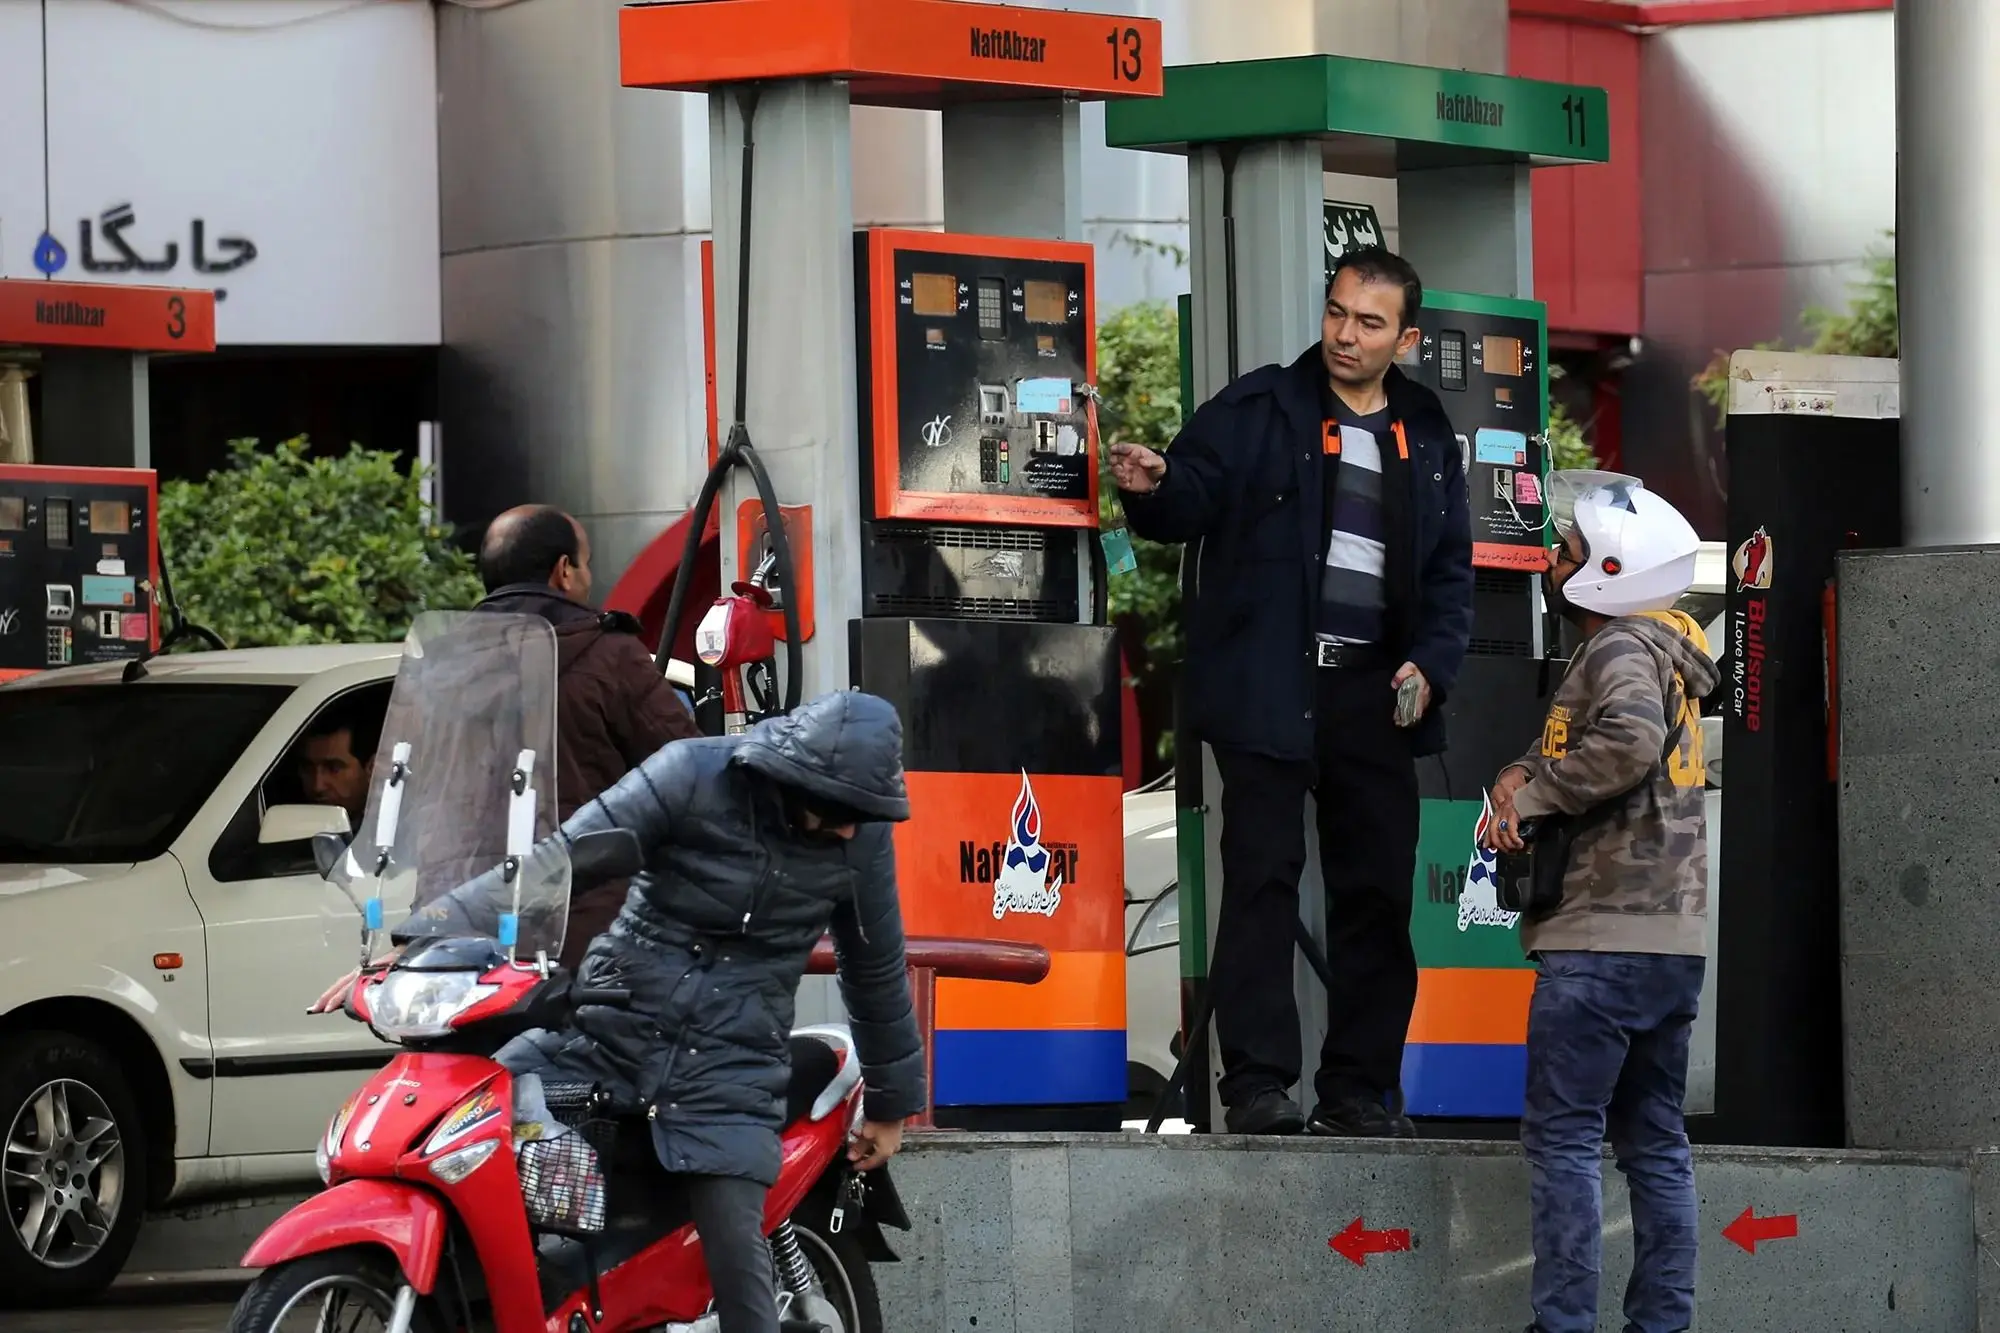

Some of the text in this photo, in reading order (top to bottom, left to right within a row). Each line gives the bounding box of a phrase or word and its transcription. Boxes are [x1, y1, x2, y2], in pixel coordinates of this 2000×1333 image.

[971, 27, 1047, 63] NaftAbzar
[1106, 26, 1142, 82] 13
[1436, 91, 1505, 127] NaftAbzar
[1561, 94, 1586, 148] 11
[36, 299, 106, 328] NaftAbzar
[167, 295, 187, 340] 3
[1735, 620, 1746, 658] Love
[1732, 660, 1745, 685] My
[1747, 599, 1767, 733] Bullsone
[1734, 687, 1745, 717] Car
